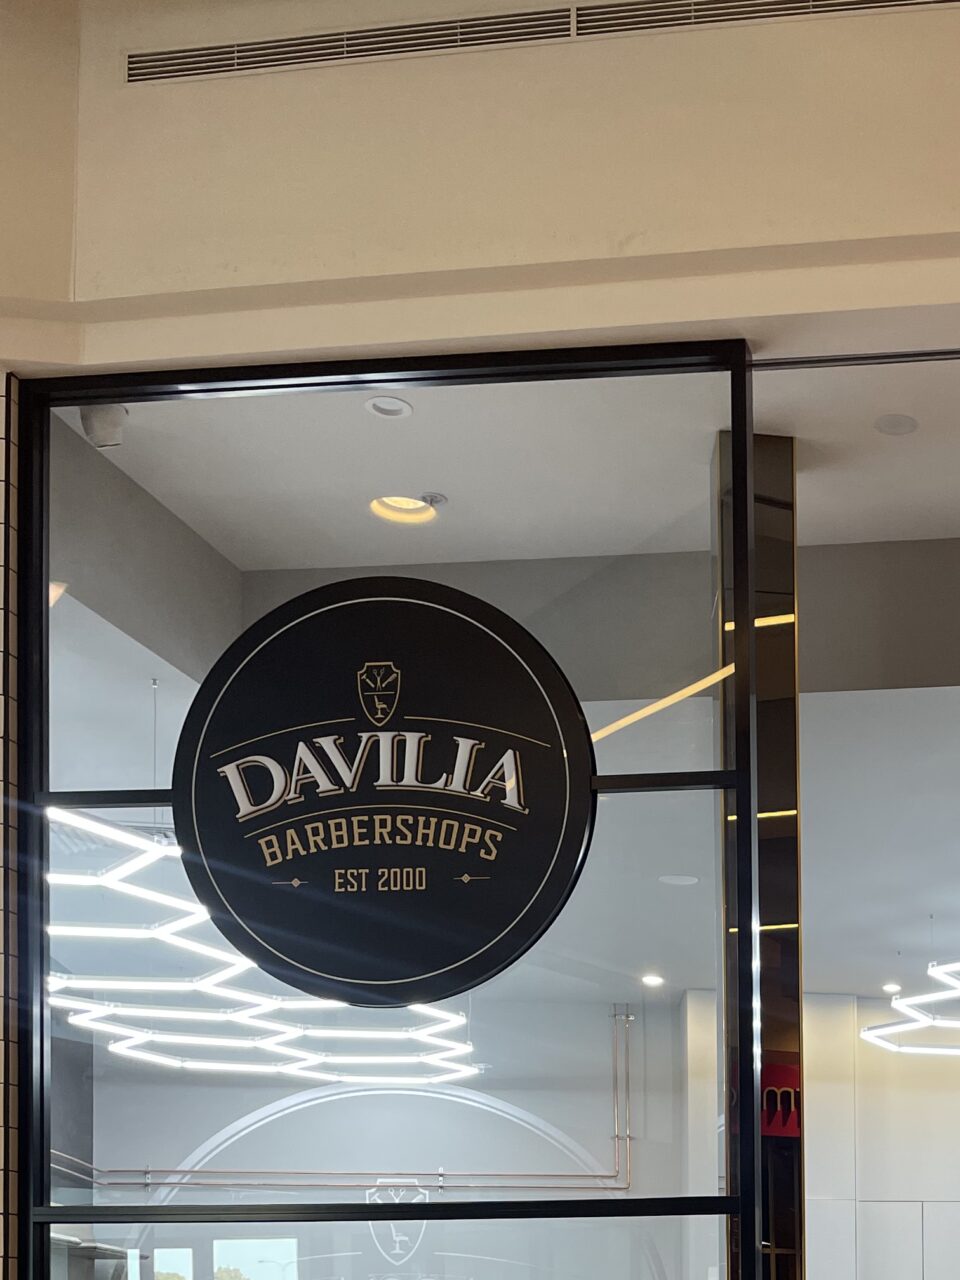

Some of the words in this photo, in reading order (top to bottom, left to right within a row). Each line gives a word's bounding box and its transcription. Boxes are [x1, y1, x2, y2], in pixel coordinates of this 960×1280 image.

[217, 731, 529, 822] DAVILIA
[258, 815, 503, 867] BARBERSHOPS
[334, 869, 369, 892] EST
[377, 867, 426, 891] 2000
